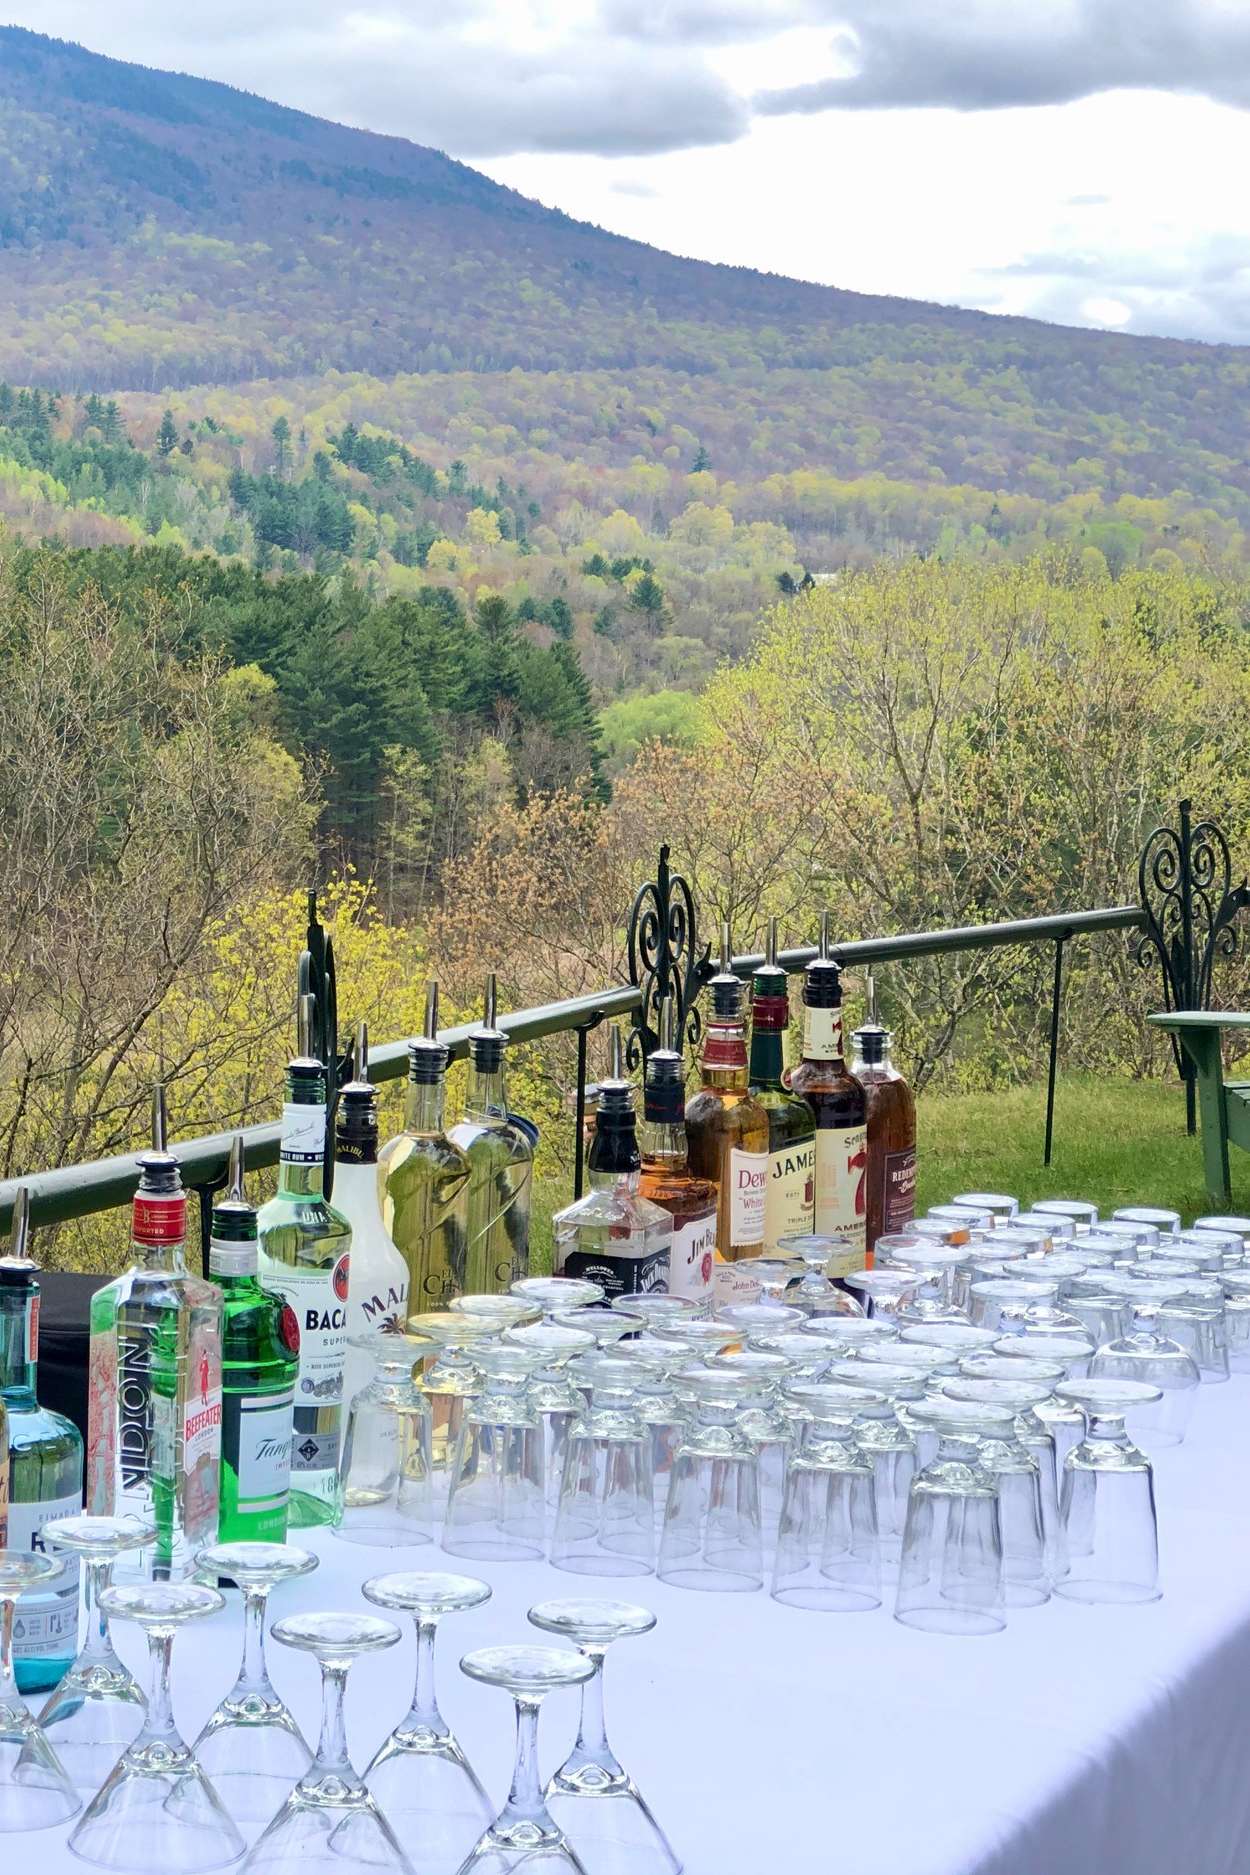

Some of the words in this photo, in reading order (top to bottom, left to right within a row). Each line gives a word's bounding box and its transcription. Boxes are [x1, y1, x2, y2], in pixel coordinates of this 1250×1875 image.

[337, 1144, 364, 1159] MALIBU
[848, 1151, 867, 1217] 7
[185, 1403, 223, 1443] BEEFEATER
[194, 1426, 214, 1442] LONDON
